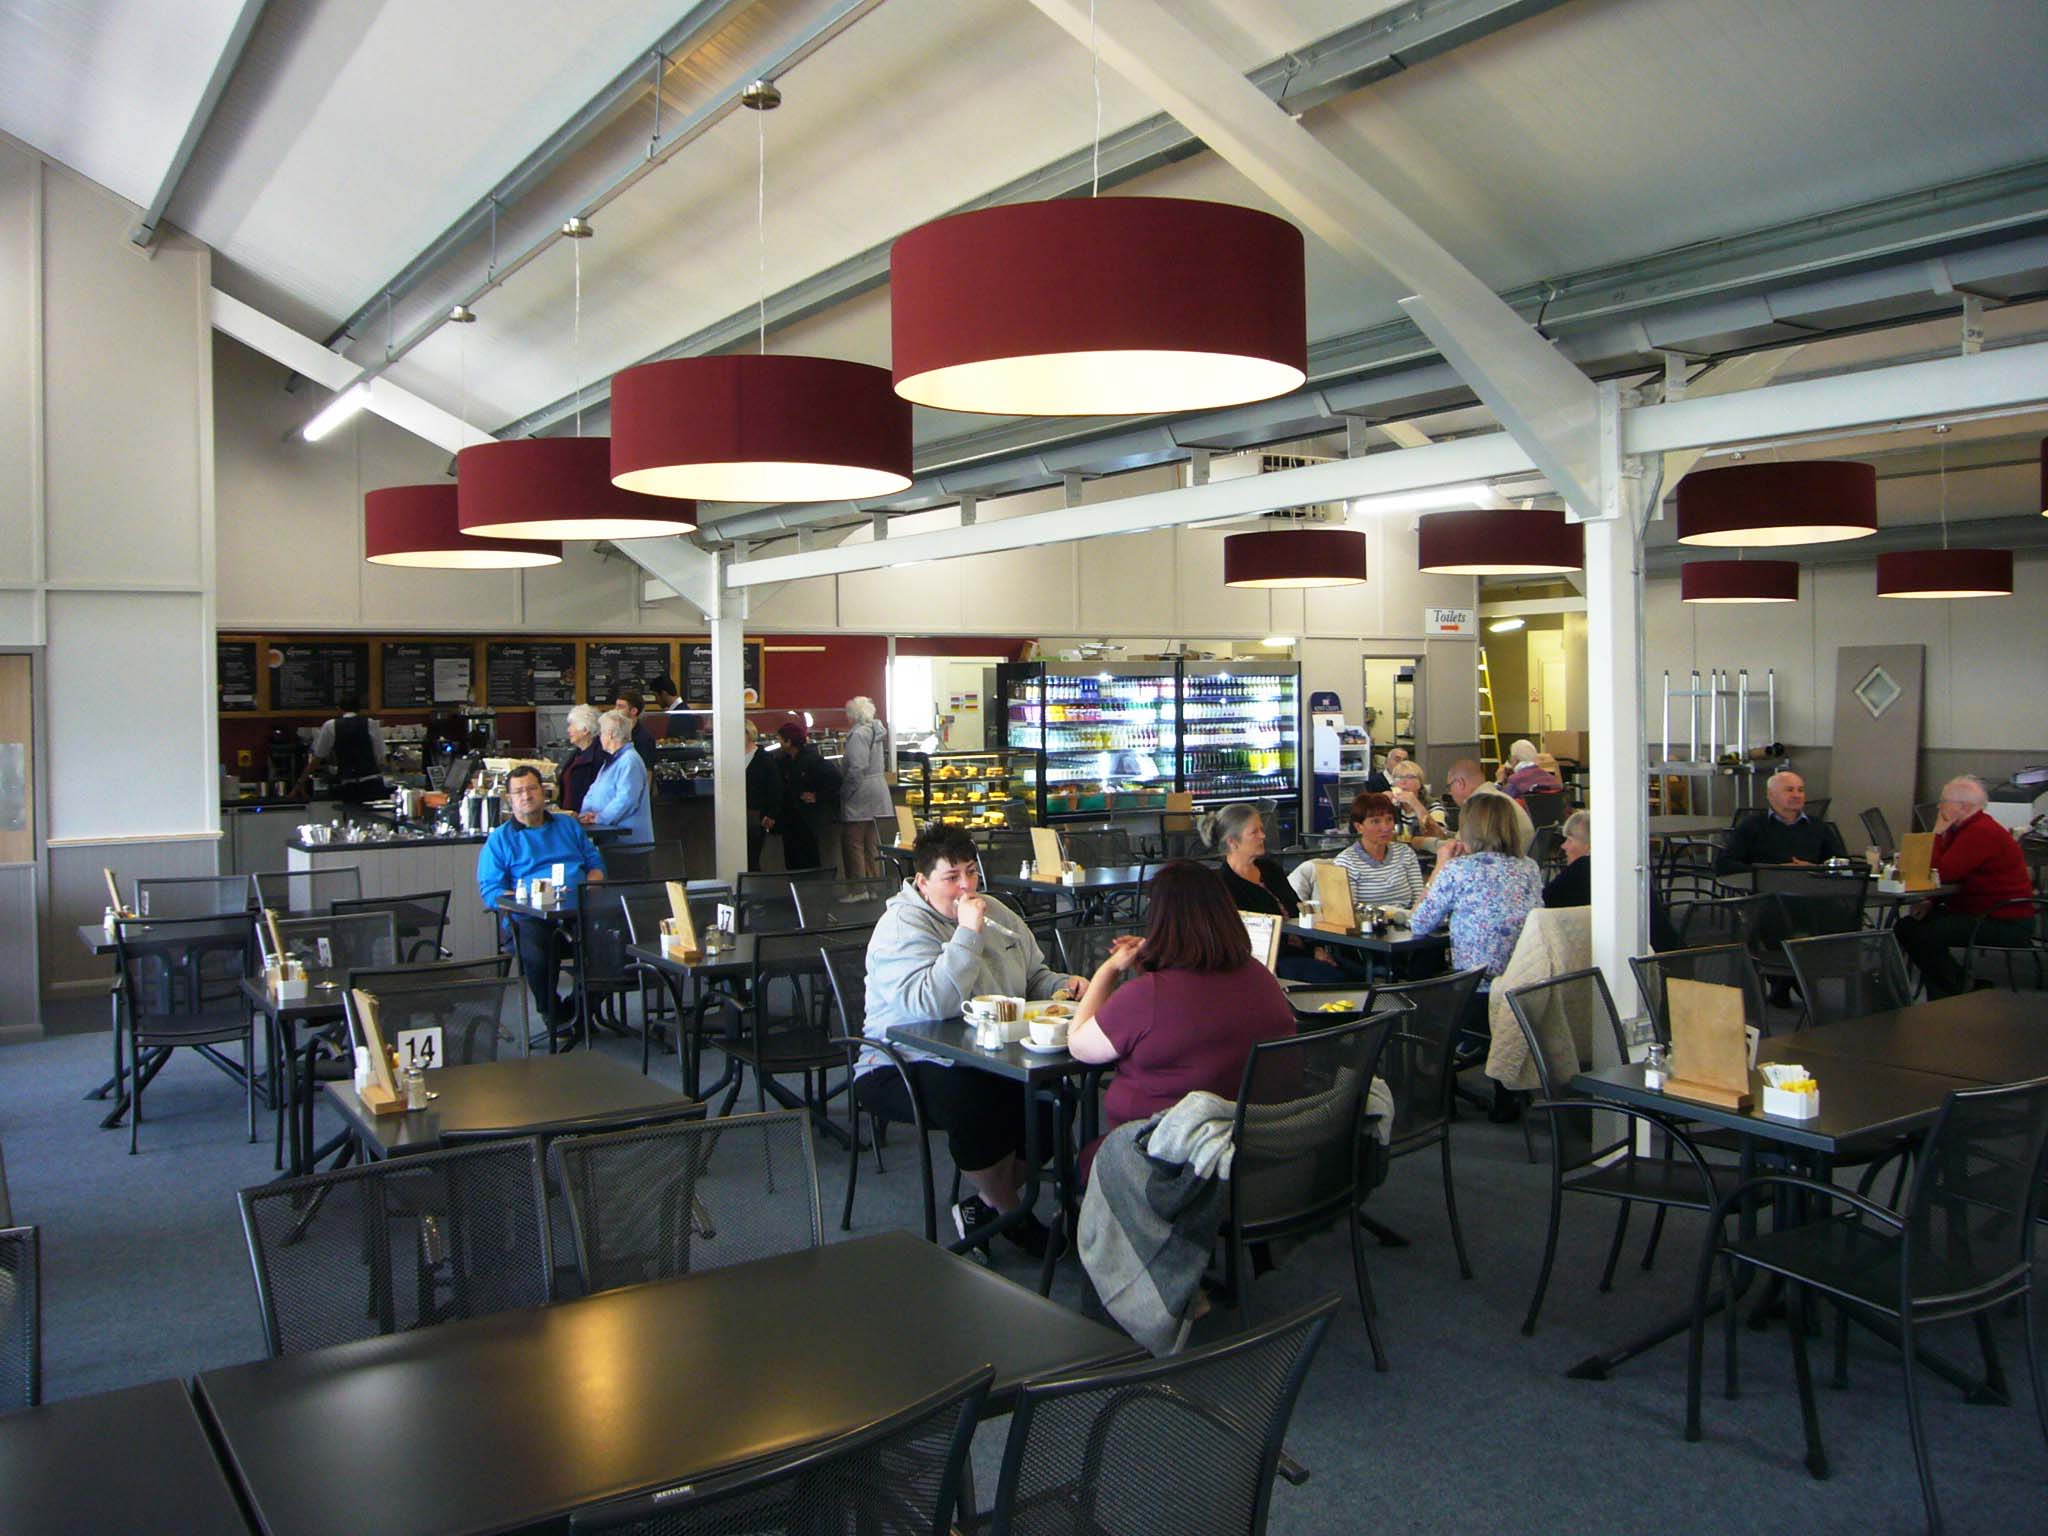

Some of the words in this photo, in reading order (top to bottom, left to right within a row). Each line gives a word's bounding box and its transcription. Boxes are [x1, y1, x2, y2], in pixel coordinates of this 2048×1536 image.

[1433, 610, 1466, 623] Toilets
[720, 909, 732, 930] 17
[405, 1035, 435, 1064] 14
